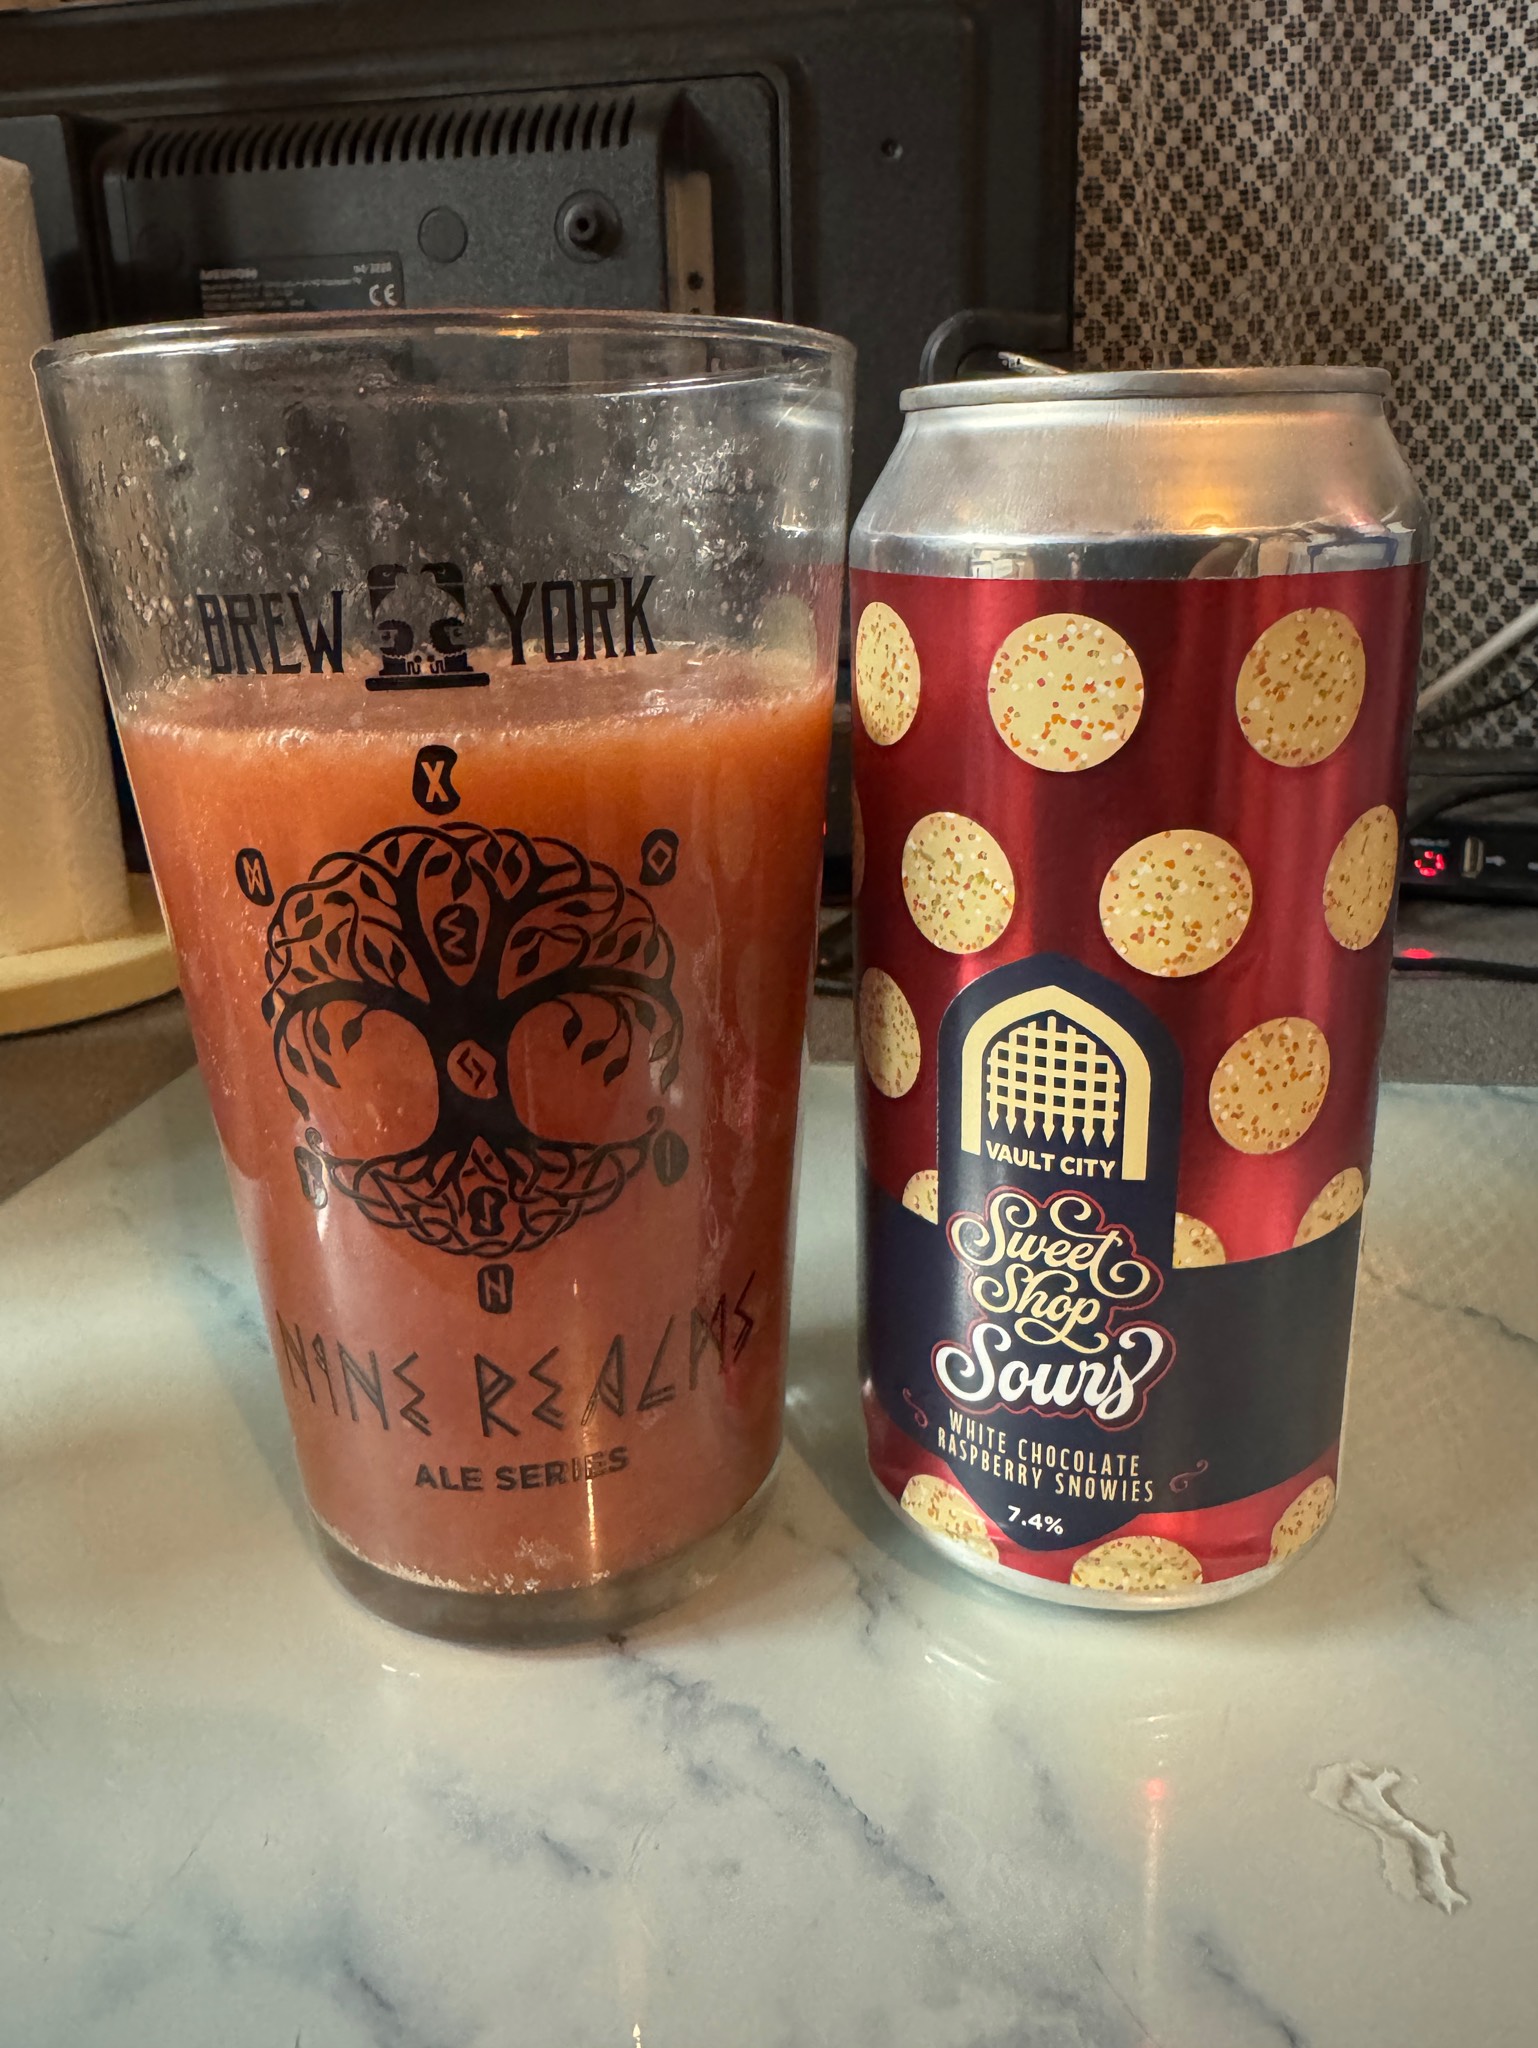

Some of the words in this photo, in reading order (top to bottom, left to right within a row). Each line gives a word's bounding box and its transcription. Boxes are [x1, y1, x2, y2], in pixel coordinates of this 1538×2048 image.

[196, 590, 344, 675] BREW
[490, 575, 658, 665] YORK
[985, 1140, 1056, 1172] VAULT
[1060, 1156, 1116, 1179] CITY
[950, 1192, 1151, 1299] Sweet
[972, 1262, 1110, 1354] Shop
[275, 1309, 433, 1437] NINE
[935, 1322, 1164, 1420] Sours
[415, 1463, 484, 1492] ALE
[496, 1446, 629, 1491] SERIES
[938, 1426, 1042, 1489] RASPBERRY
[1055, 1472, 1154, 1502] SNOWIES
[949, 1408, 1006, 1453] WHITE
[1018, 1438, 1140, 1477] CHOCOLATE
[1007, 1505, 1064, 1535] 7.4%
